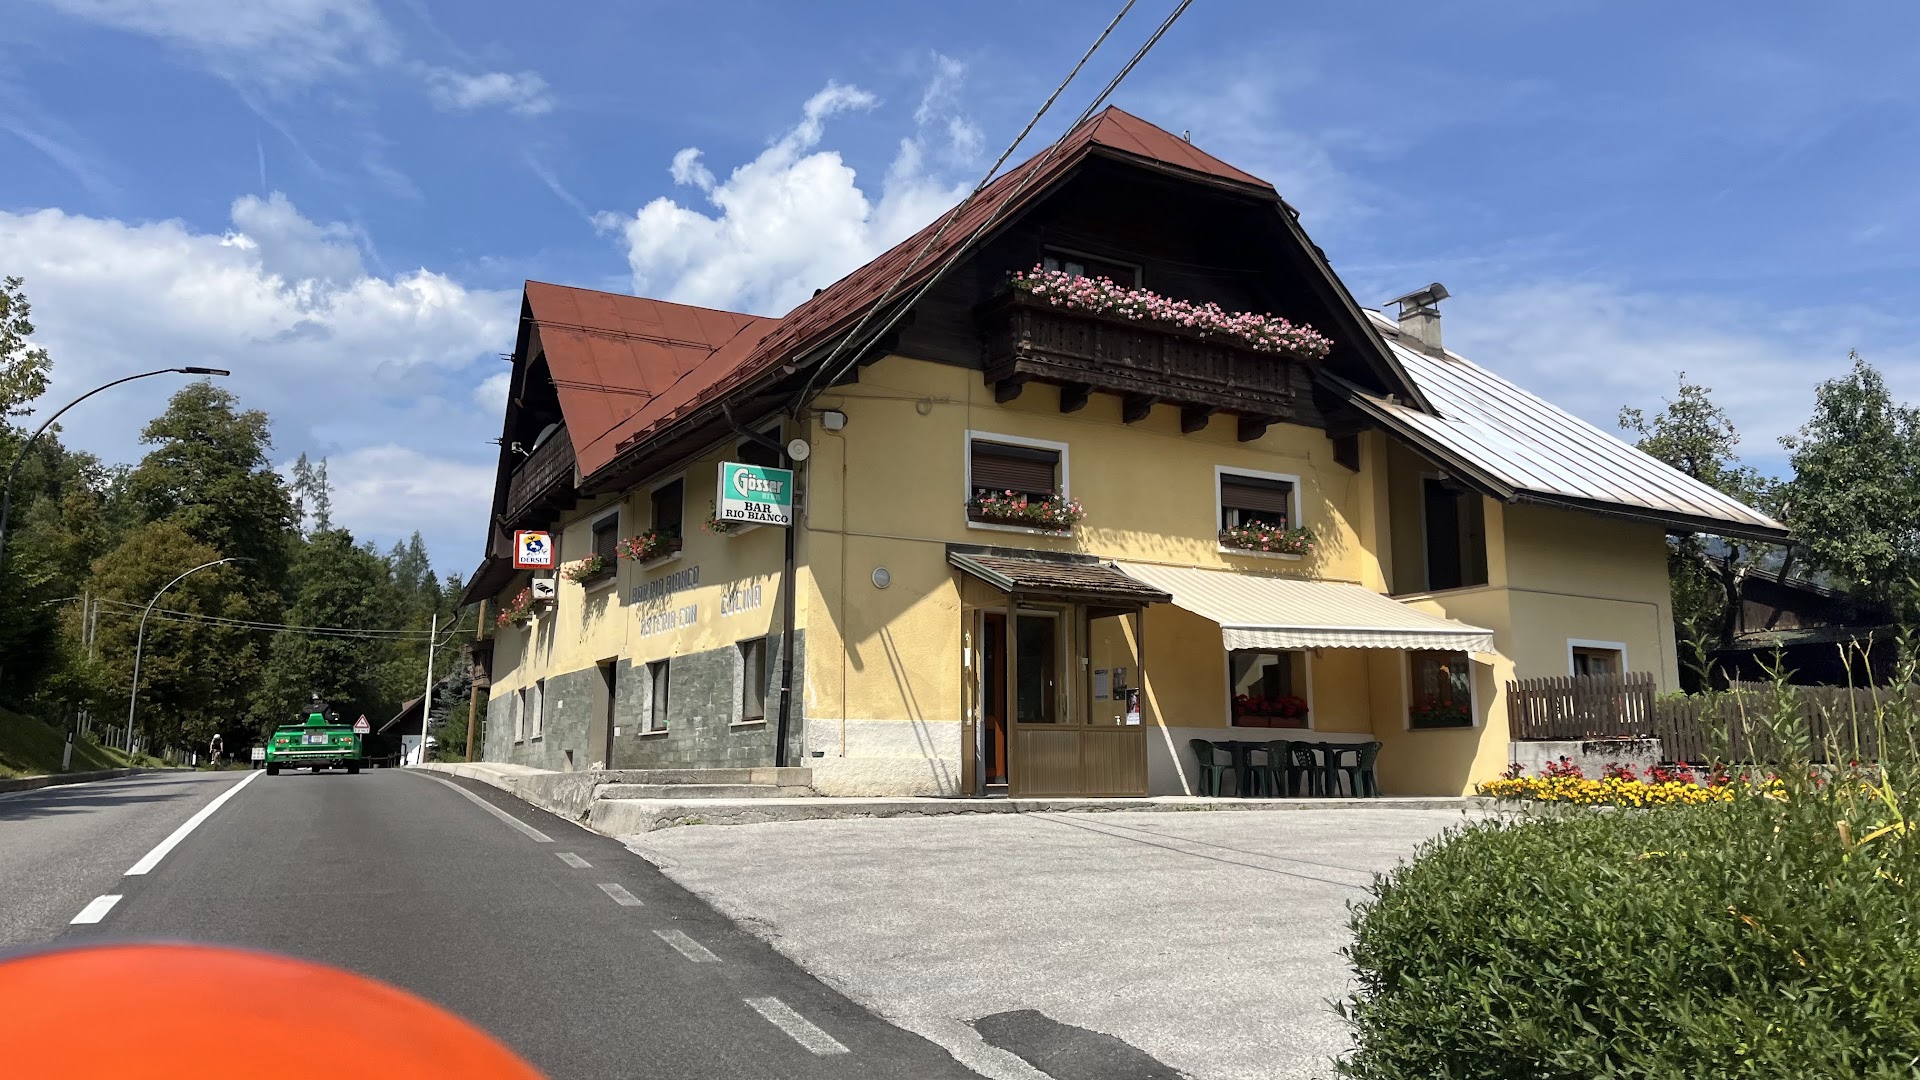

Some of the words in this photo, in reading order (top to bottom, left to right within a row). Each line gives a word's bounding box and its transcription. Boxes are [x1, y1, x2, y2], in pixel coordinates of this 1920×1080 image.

[733, 468, 783, 498] Gösser
[725, 509, 744, 518] RIO
[747, 511, 789, 523] BIANCO
[744, 501, 772, 513] BAR
[666, 565, 700, 596] BIANCO
[720, 584, 762, 617] CUCINA
